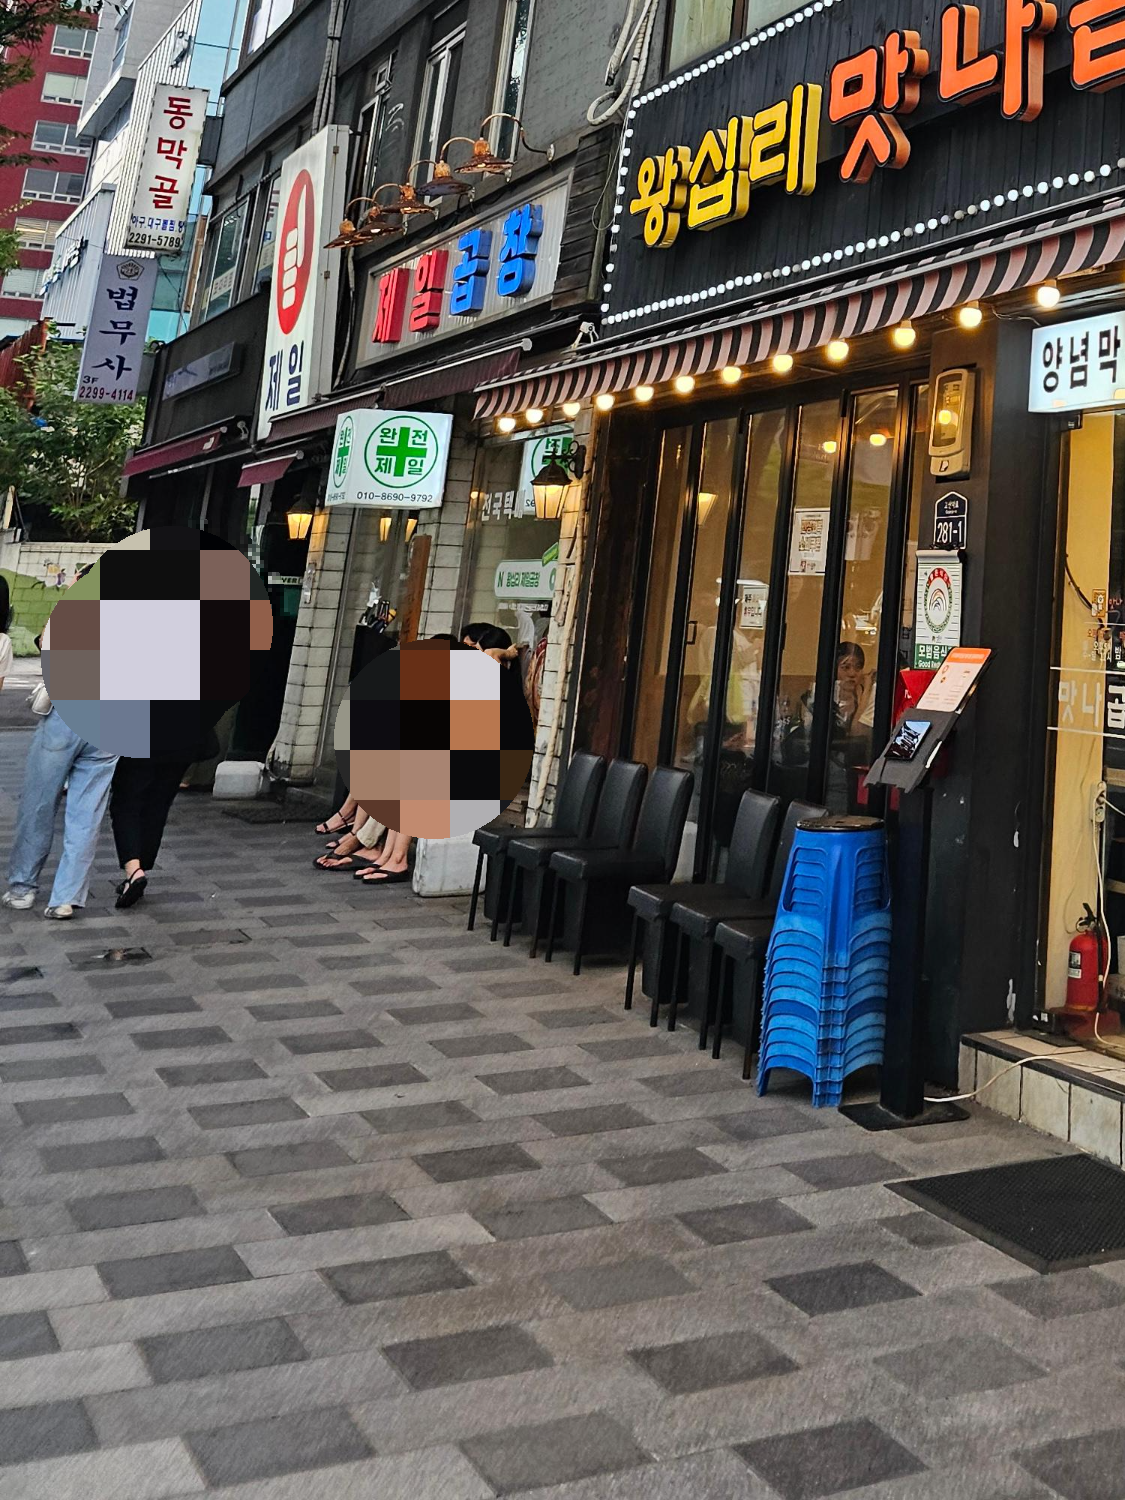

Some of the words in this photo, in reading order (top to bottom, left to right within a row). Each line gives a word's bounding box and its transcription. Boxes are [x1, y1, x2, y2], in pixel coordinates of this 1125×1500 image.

[148, 96, 193, 209] 동막골
[630, 82, 822, 248] 왕십리
[128, 232, 181, 248] 2291-5789
[372, 203, 543, 343] 제일곱창
[91, 286, 138, 381] 법무사
[78, 386, 134, 401] 2299-4114
[82, 375, 99, 385] 3F
[265, 340, 304, 411] 제일
[357, 491, 433, 503] 010-8690-9792
[937, 520, 962, 544] 281-1
